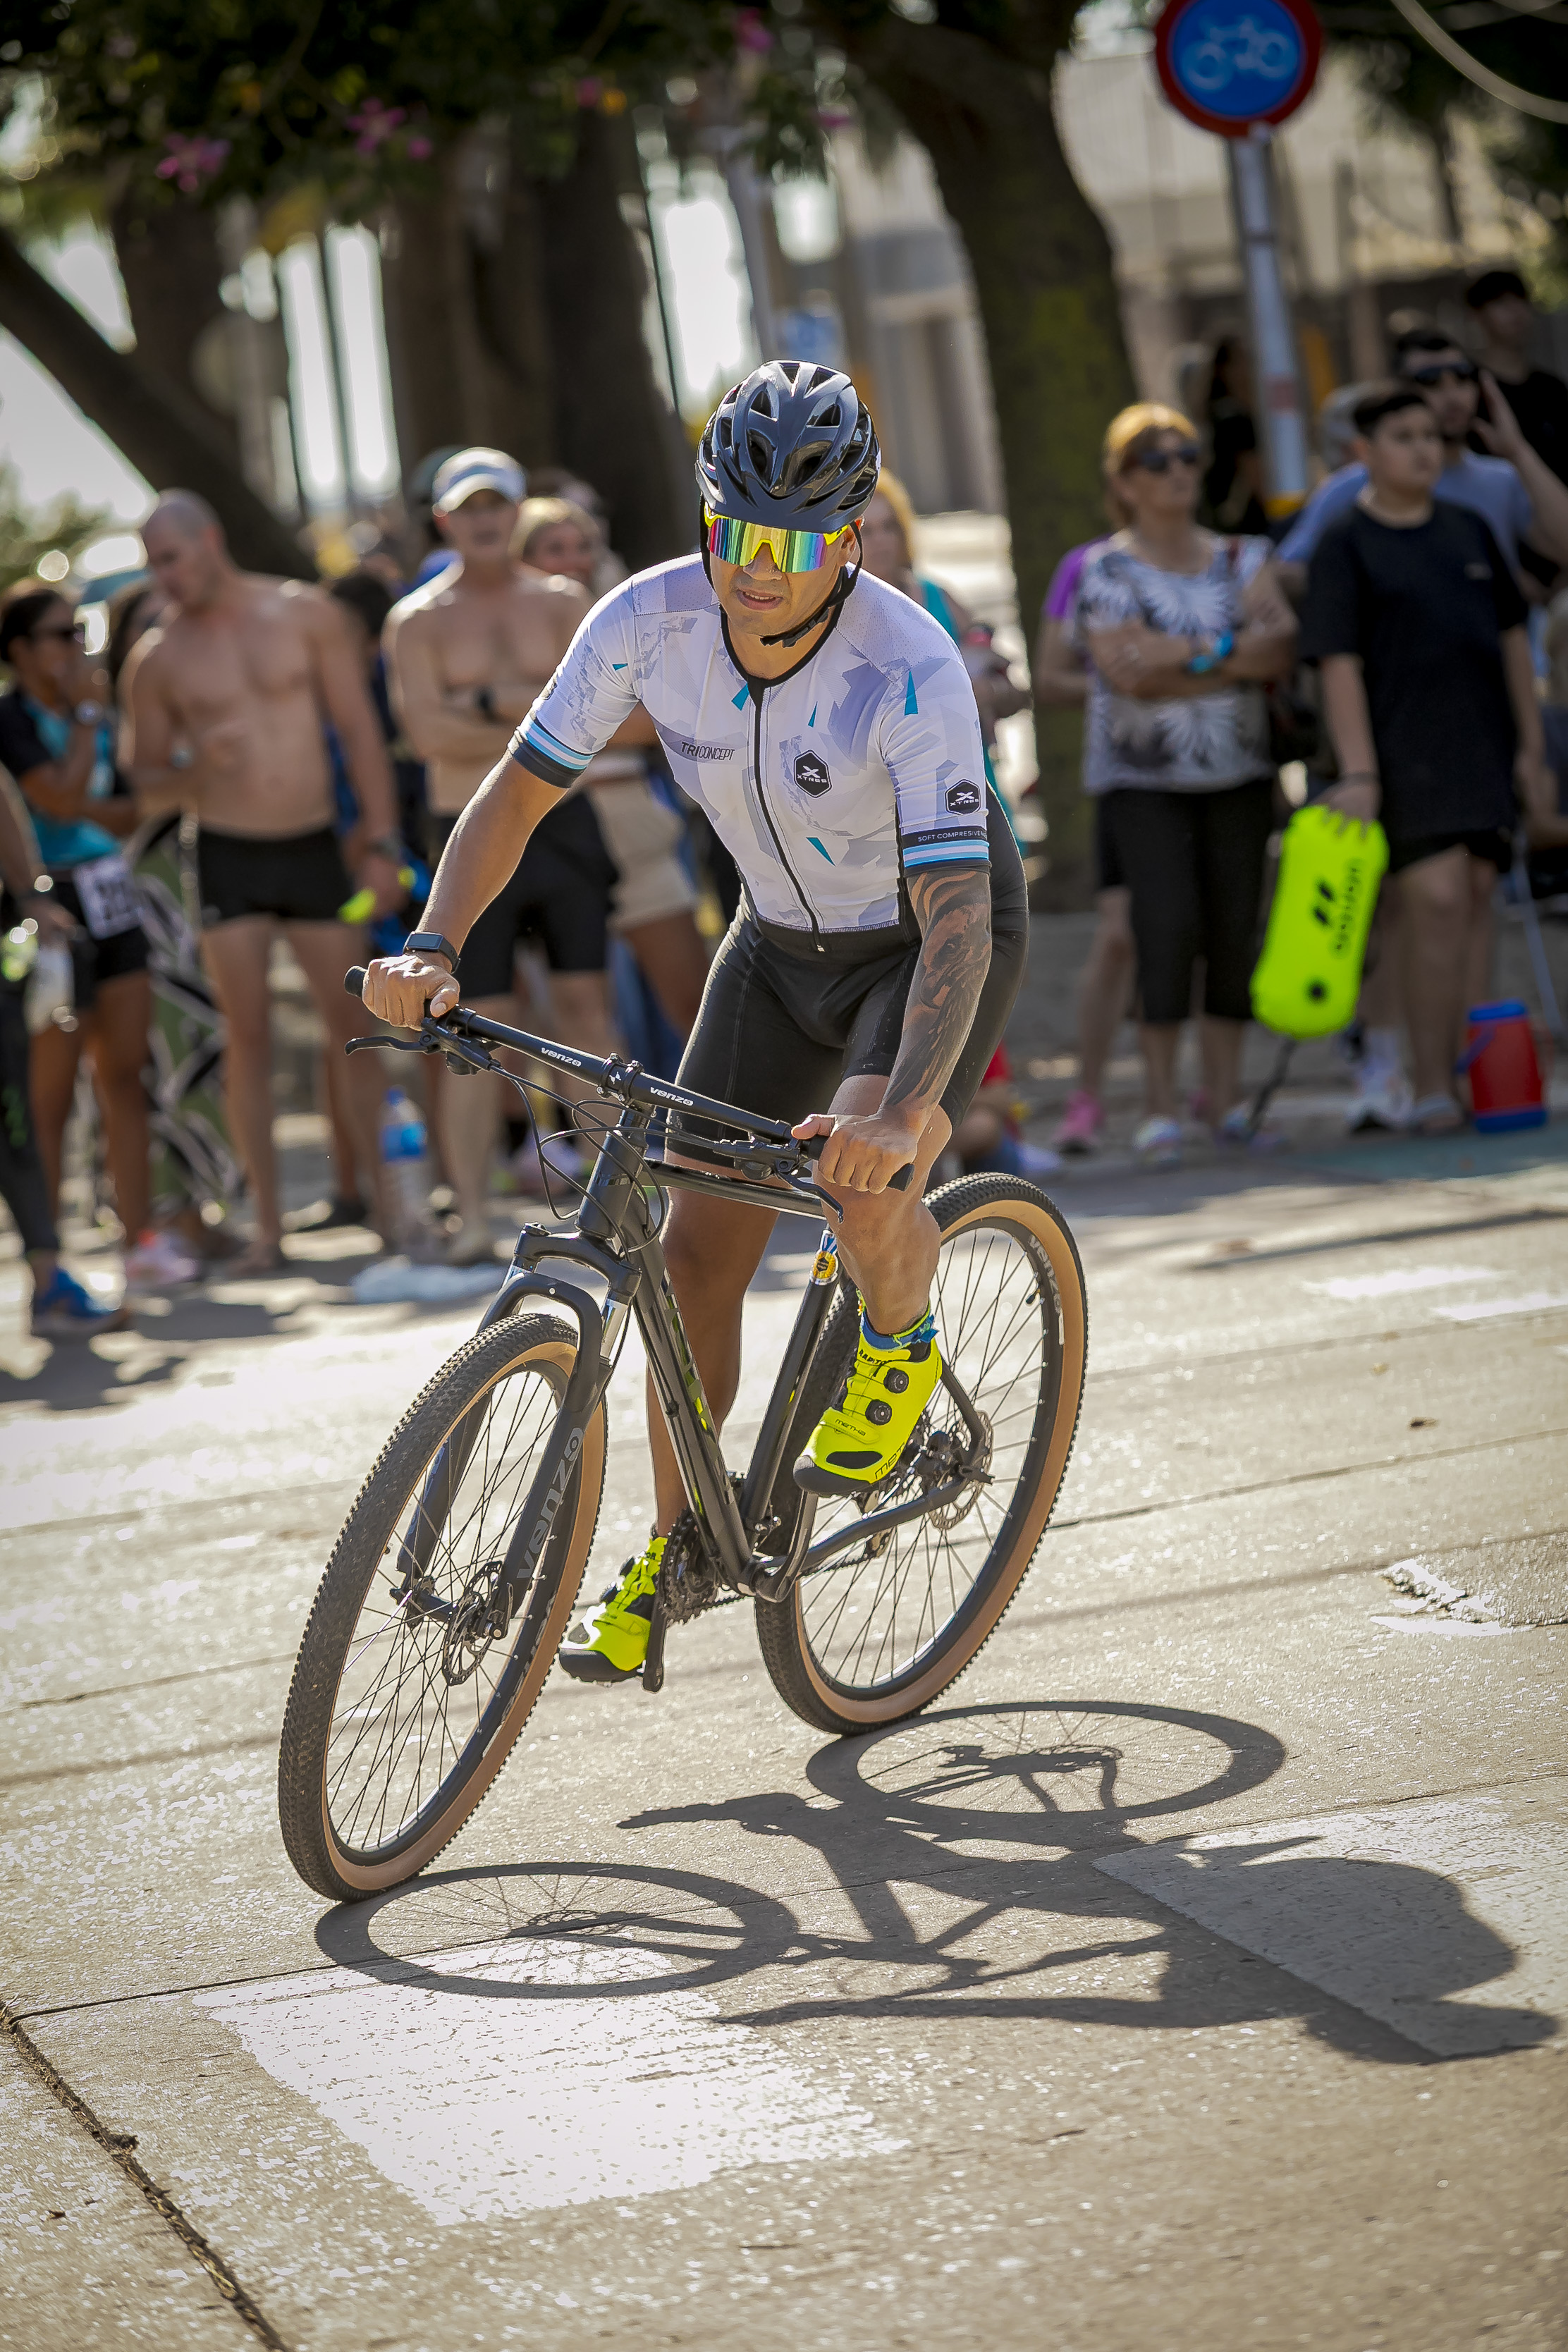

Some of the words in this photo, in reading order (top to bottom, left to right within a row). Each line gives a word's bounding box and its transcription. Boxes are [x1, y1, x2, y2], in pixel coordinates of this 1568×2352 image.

[681, 741, 735, 761] TRICONCEPT
[541, 1047, 582, 1067] venzo
[650, 1086, 694, 1106] venzo
[516, 1427, 586, 1579] venzo
